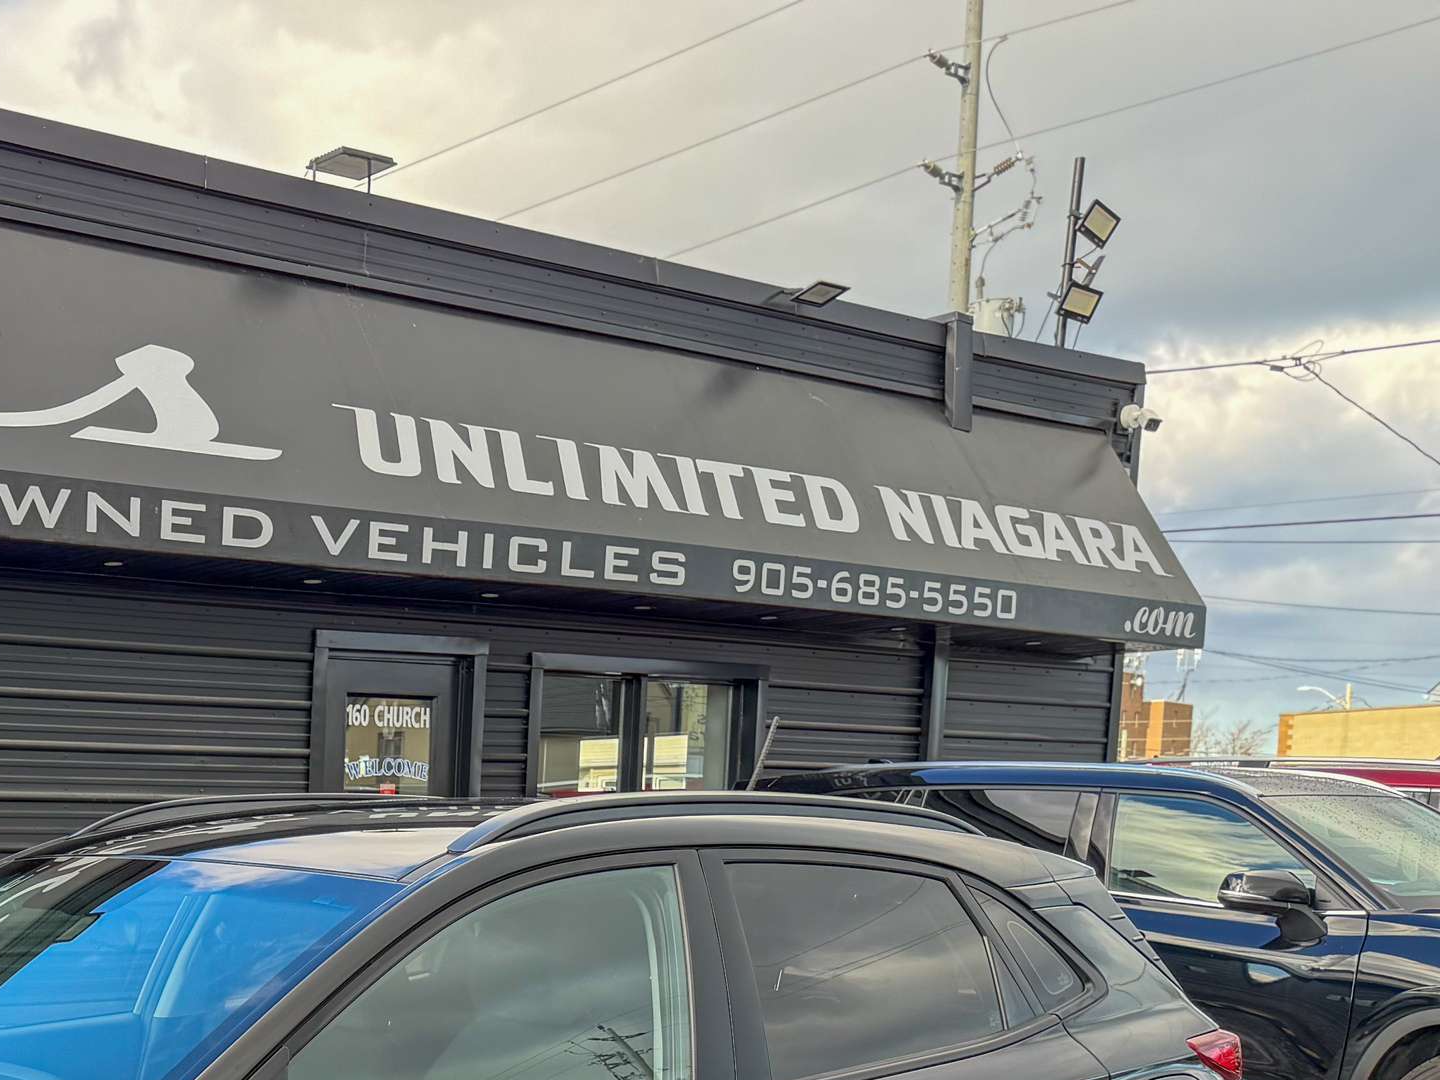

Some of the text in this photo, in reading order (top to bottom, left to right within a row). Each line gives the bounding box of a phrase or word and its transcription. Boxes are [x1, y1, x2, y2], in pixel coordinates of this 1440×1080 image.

[332, 403, 859, 534] UNLIMITED
[873, 485, 1174, 578] NIAGARA
[311, 515, 686, 586] VEHICLES
[732, 559, 1017, 620] 905-685-5550
[1124, 606, 1197, 638] .com
[346, 704, 430, 728] 160 CHURCH
[345, 757, 429, 781] WELCOME
